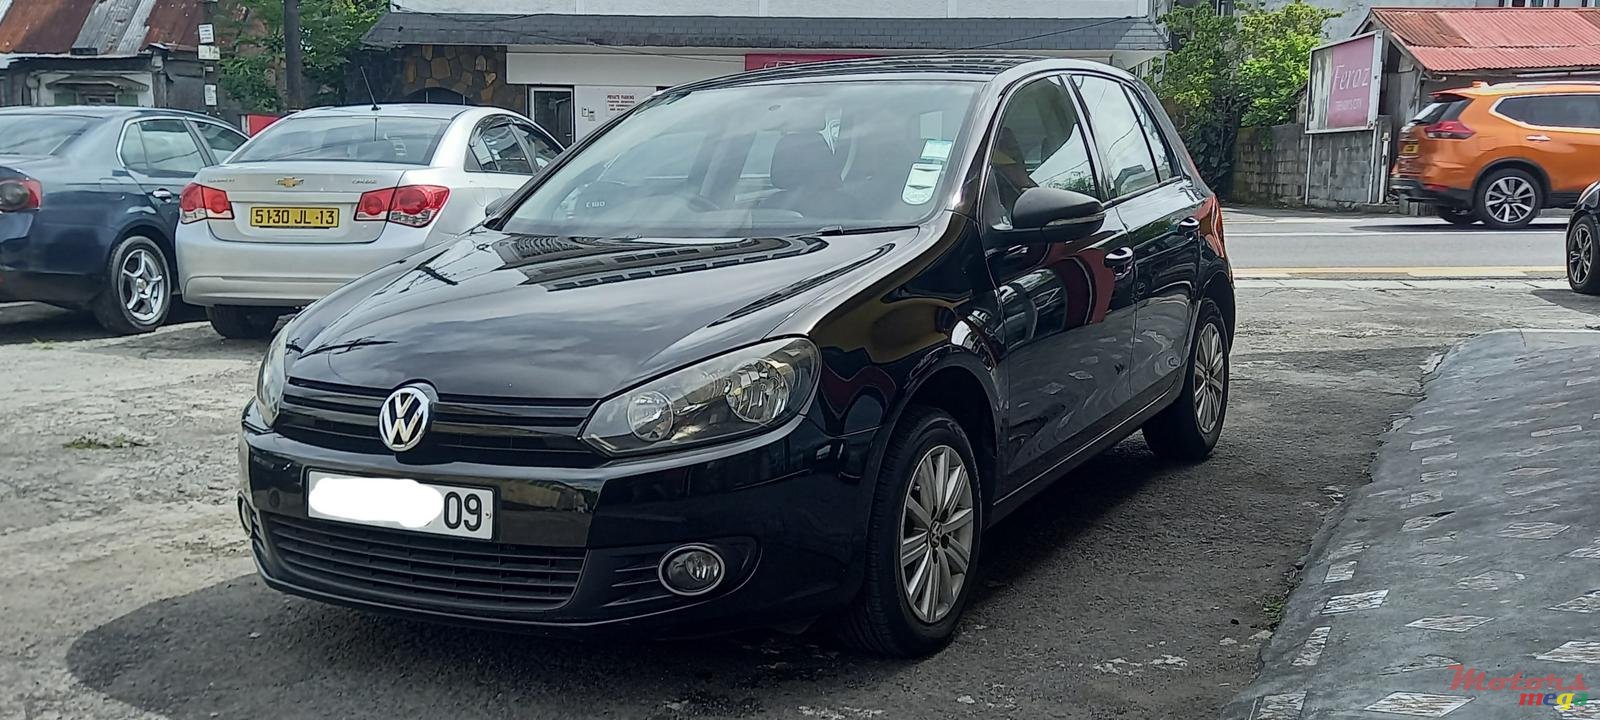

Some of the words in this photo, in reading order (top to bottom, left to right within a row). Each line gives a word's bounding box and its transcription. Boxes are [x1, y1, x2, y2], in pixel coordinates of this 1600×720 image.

[255, 209, 290, 224] 5130
[294, 209, 311, 224] JL
[443, 491, 482, 532] 09
